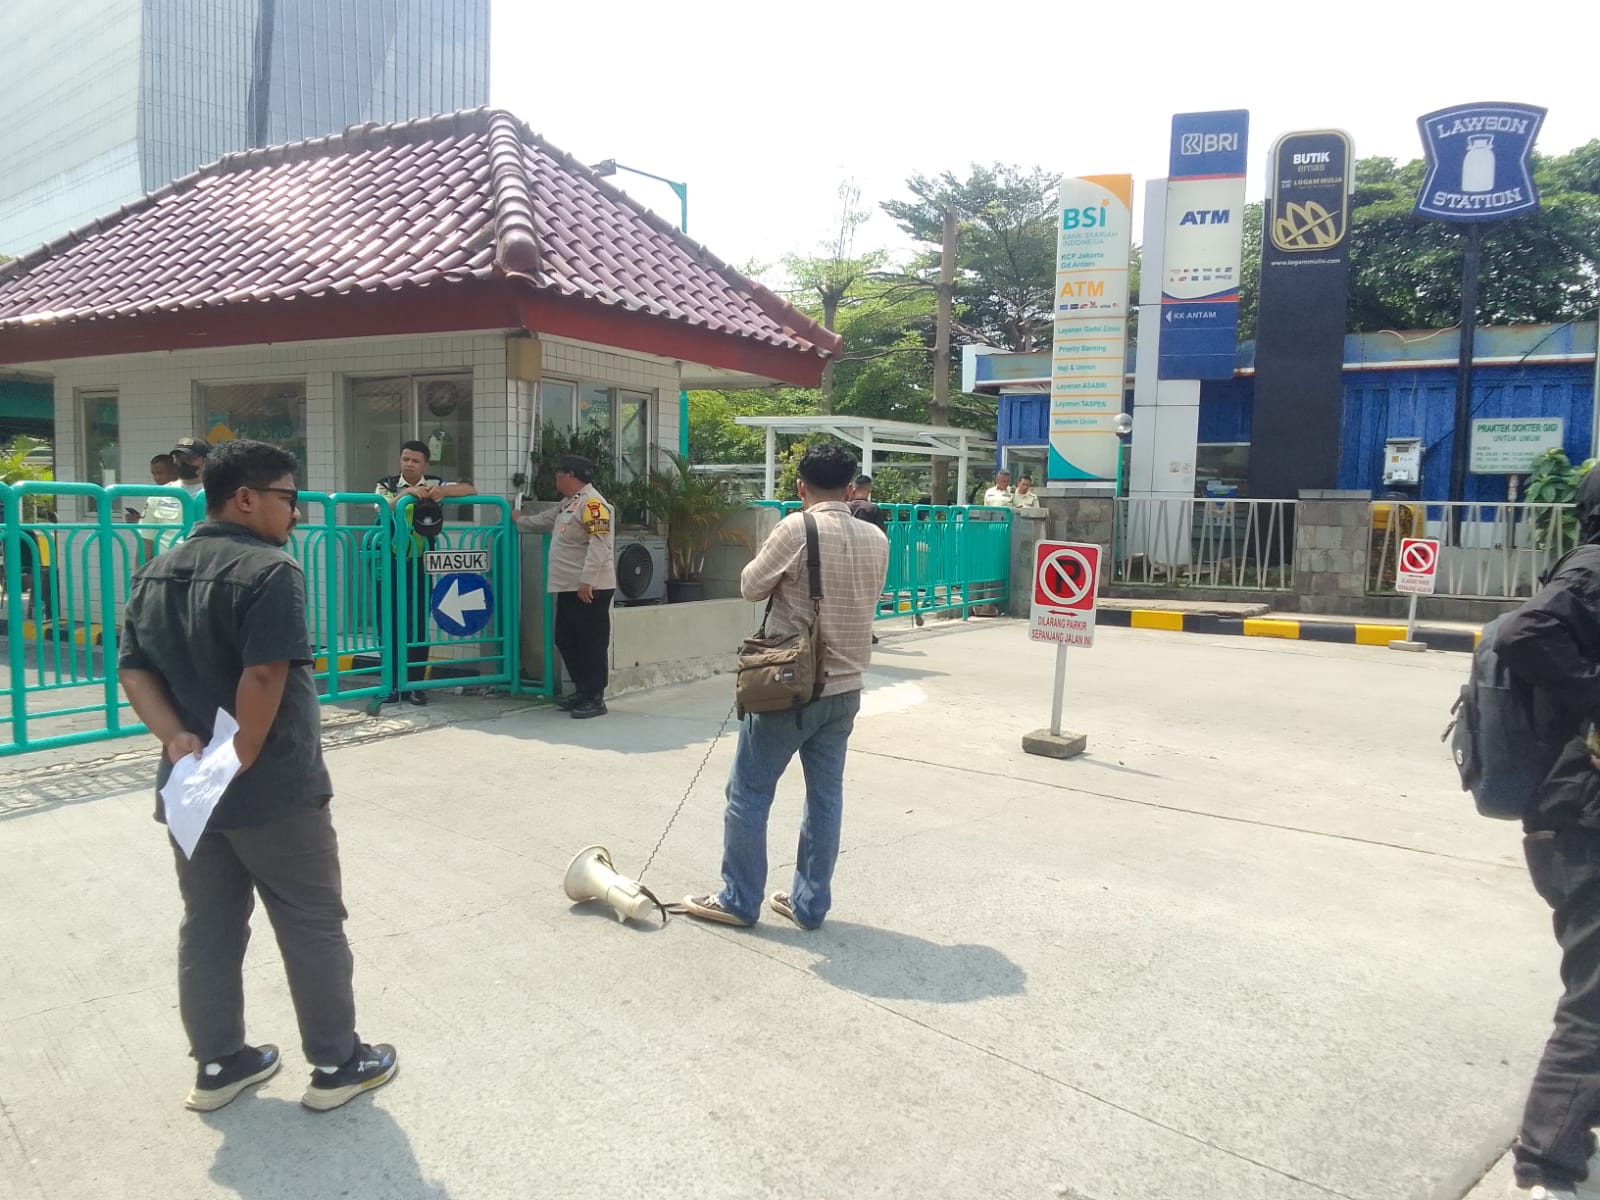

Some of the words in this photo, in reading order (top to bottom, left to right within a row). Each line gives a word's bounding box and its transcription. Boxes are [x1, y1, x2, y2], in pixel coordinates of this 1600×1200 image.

[1437, 116, 1528, 139] LAWSON
[1204, 132, 1239, 152] BRI
[1293, 152, 1330, 165] BUTIK
[1297, 165, 1325, 173] emas
[1293, 178, 1319, 186] LOGAM
[1432, 187, 1523, 209] STATION
[1062, 199, 1109, 230] BSI
[1179, 209, 1231, 226] ATM
[1062, 238, 1104, 247] INDONESIA
[1060, 281, 1105, 298] ATM
[1186, 311, 1217, 319] ANTAM
[1477, 423, 1510, 433] PRAKTEK
[1511, 423, 1541, 432] DOKTER
[1543, 423, 1559, 432] GIGI
[429, 554, 483, 570] MASUK
[1037, 615, 1066, 629] DILARANG
[1066, 620, 1088, 631] PARKIR
[1031, 628, 1064, 642] SEPANJANG
